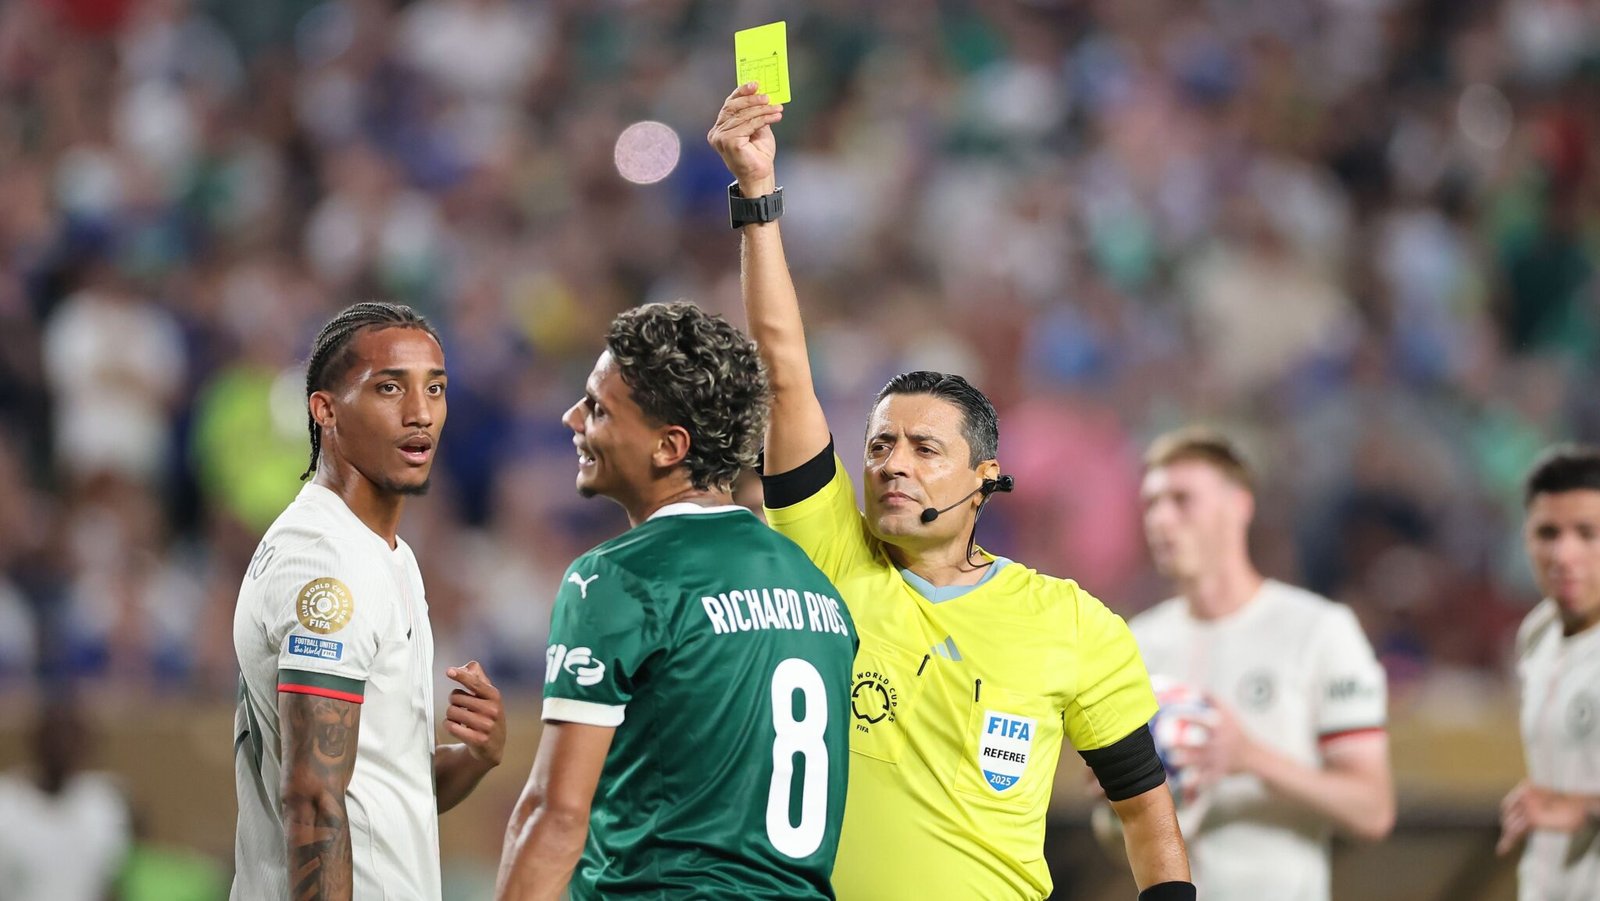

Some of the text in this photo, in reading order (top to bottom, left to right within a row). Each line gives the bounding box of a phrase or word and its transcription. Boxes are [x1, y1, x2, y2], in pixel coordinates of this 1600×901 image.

[304, 583, 330, 598] WORLD
[332, 584, 345, 597] CUP
[301, 599, 309, 617] CLUB
[701, 588, 848, 636] RICHARD RIOS
[309, 618, 331, 629] FIFA
[294, 637, 338, 650] FOOTBALL UNITES
[857, 671, 889, 685] WORLD
[889, 687, 897, 707] CUP
[856, 724, 869, 734] FIFA
[987, 716, 1029, 741] FIFA
[766, 658, 829, 859] 8
[983, 747, 1026, 764] REFEREE
[990, 774, 1012, 786] 2025
